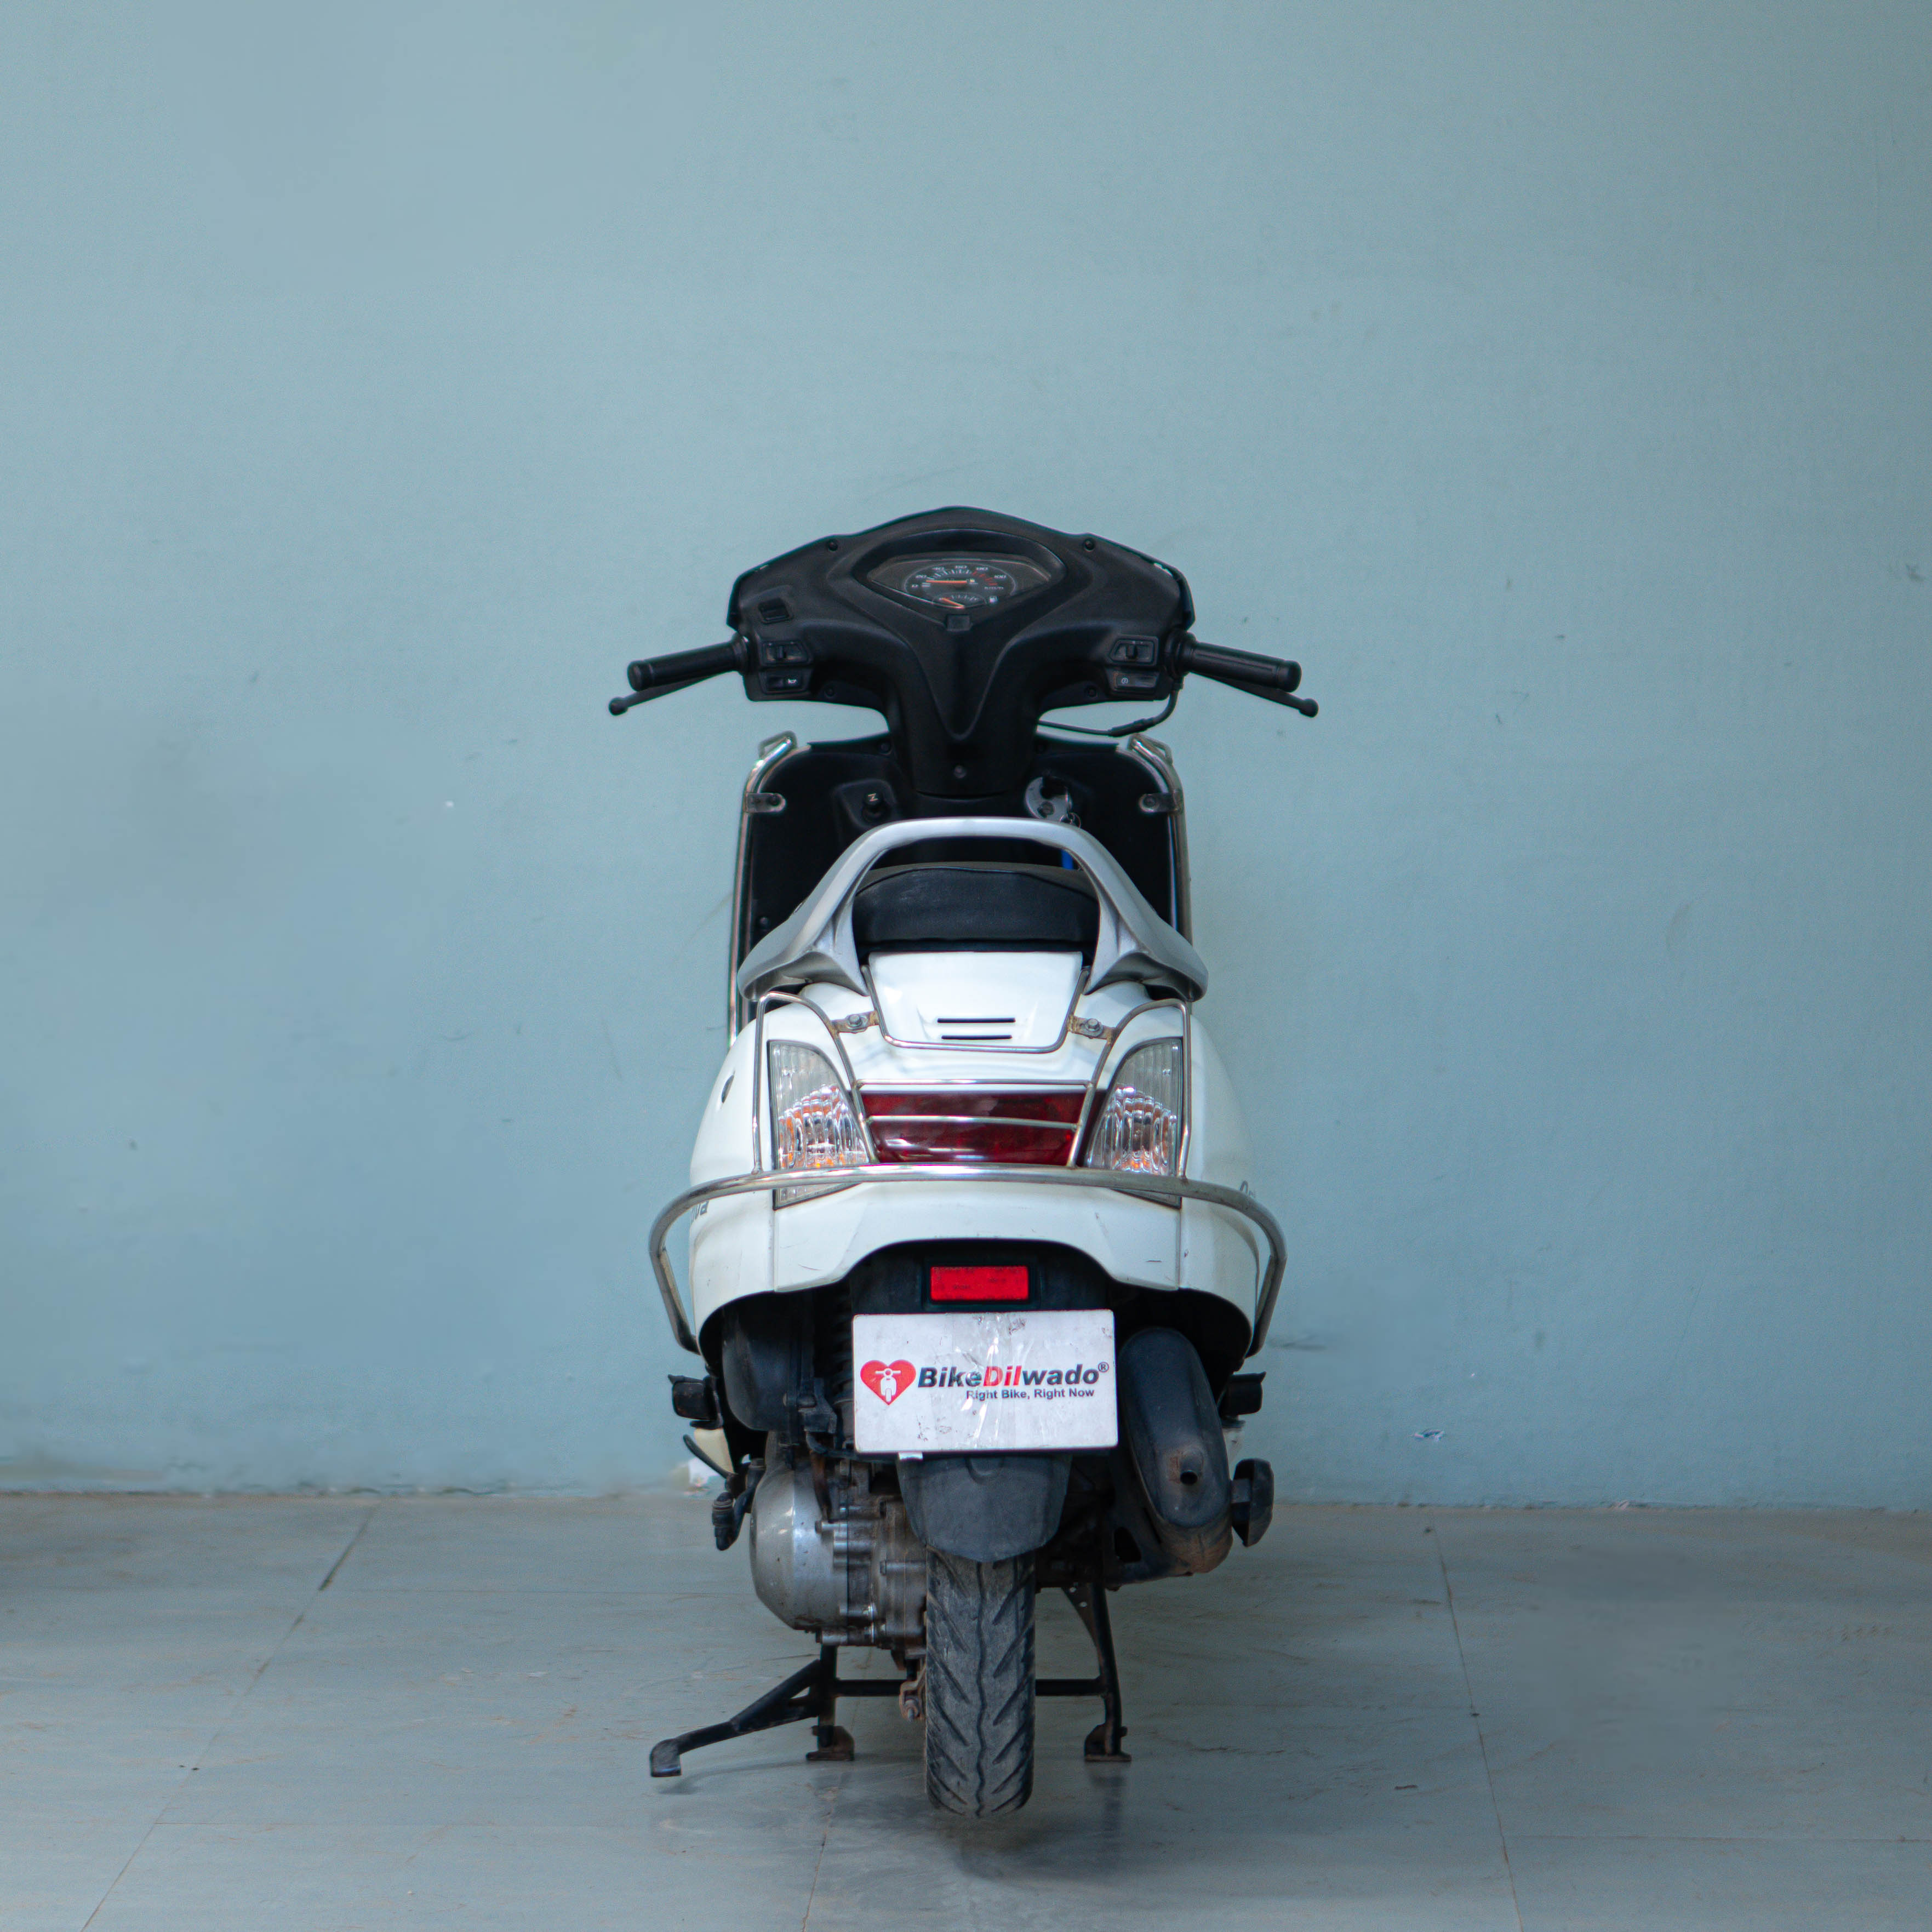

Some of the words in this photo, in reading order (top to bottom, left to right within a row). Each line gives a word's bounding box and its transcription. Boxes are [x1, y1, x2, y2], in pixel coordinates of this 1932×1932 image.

[966, 1390, 997, 1401] Right
[1002, 1389, 1030, 1399] Bike,
[1034, 1388, 1065, 1399] Right
[1069, 1388, 1095, 1397] Now
